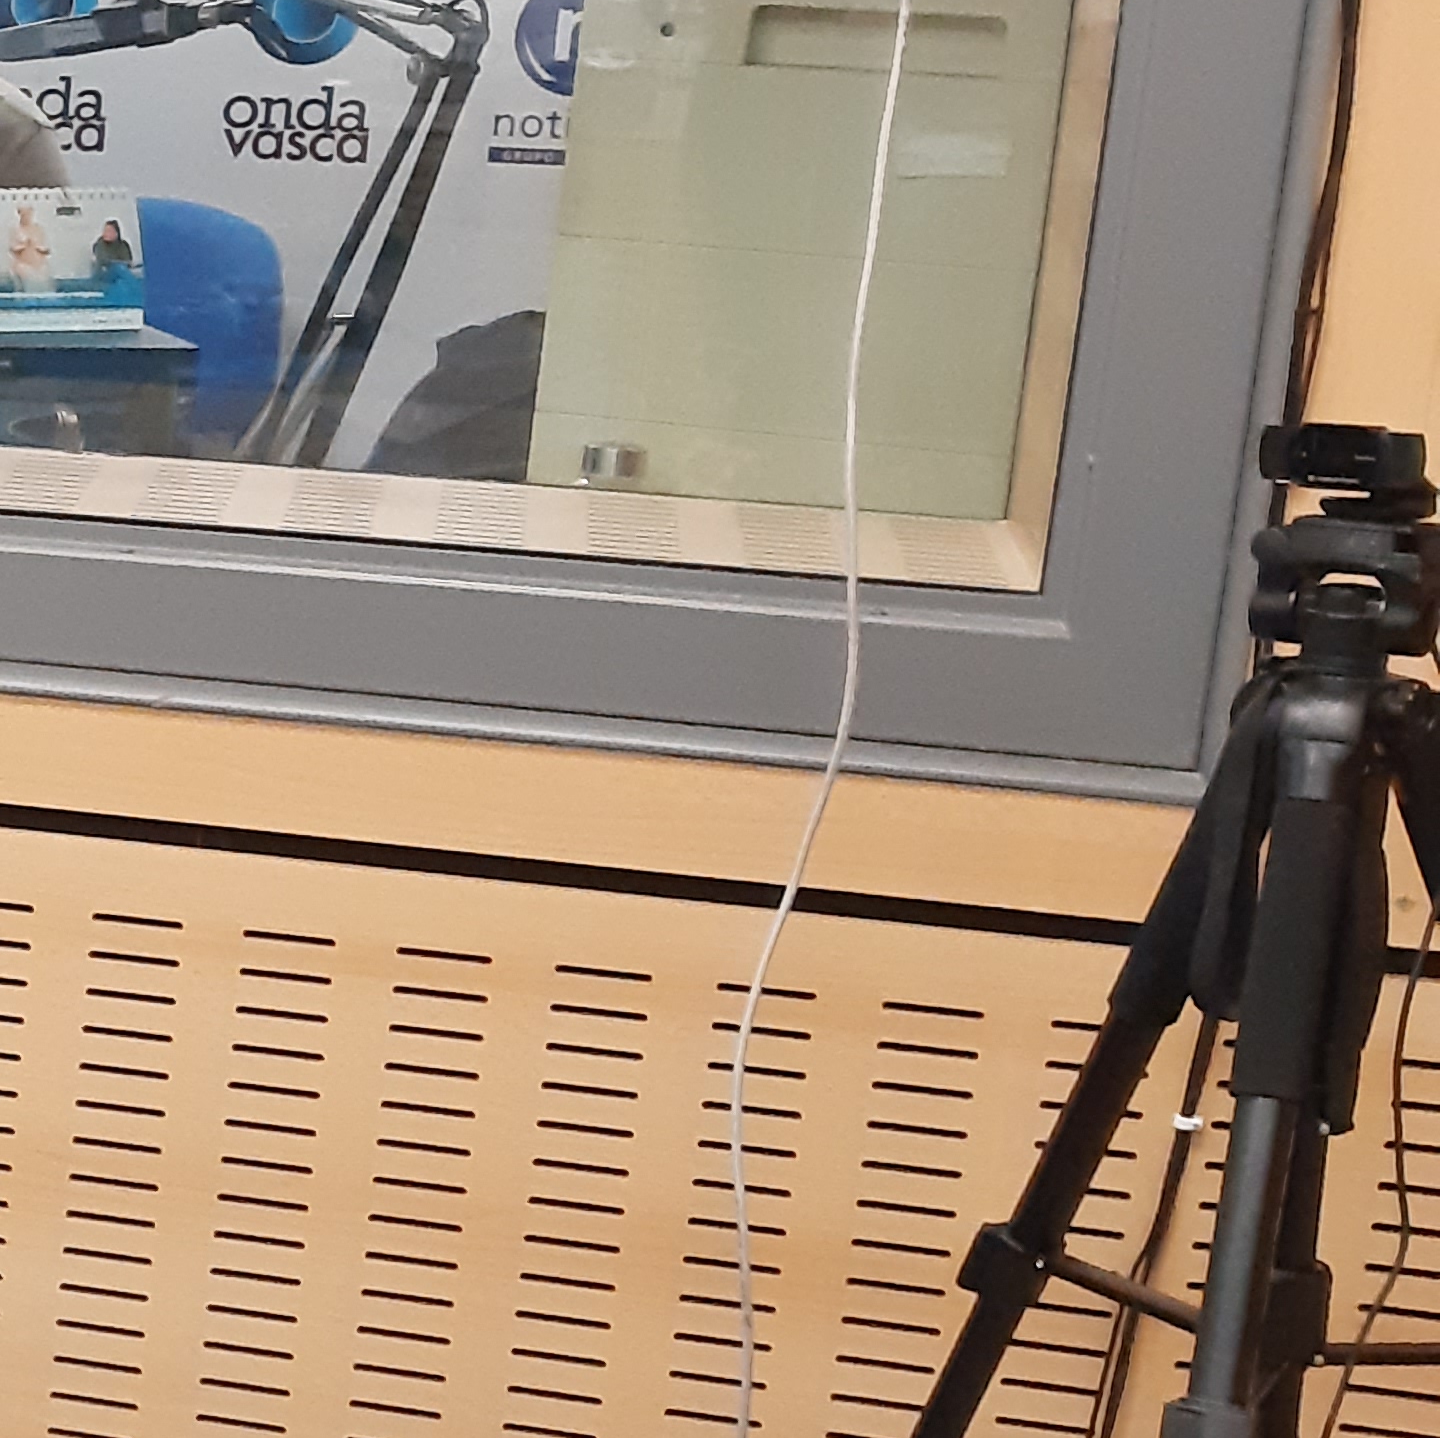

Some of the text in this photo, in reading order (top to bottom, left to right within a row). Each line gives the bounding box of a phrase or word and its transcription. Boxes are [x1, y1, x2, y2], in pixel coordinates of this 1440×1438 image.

[20, 76, 106, 121] da
[223, 86, 371, 133] onda
[224, 129, 370, 163] vasca
